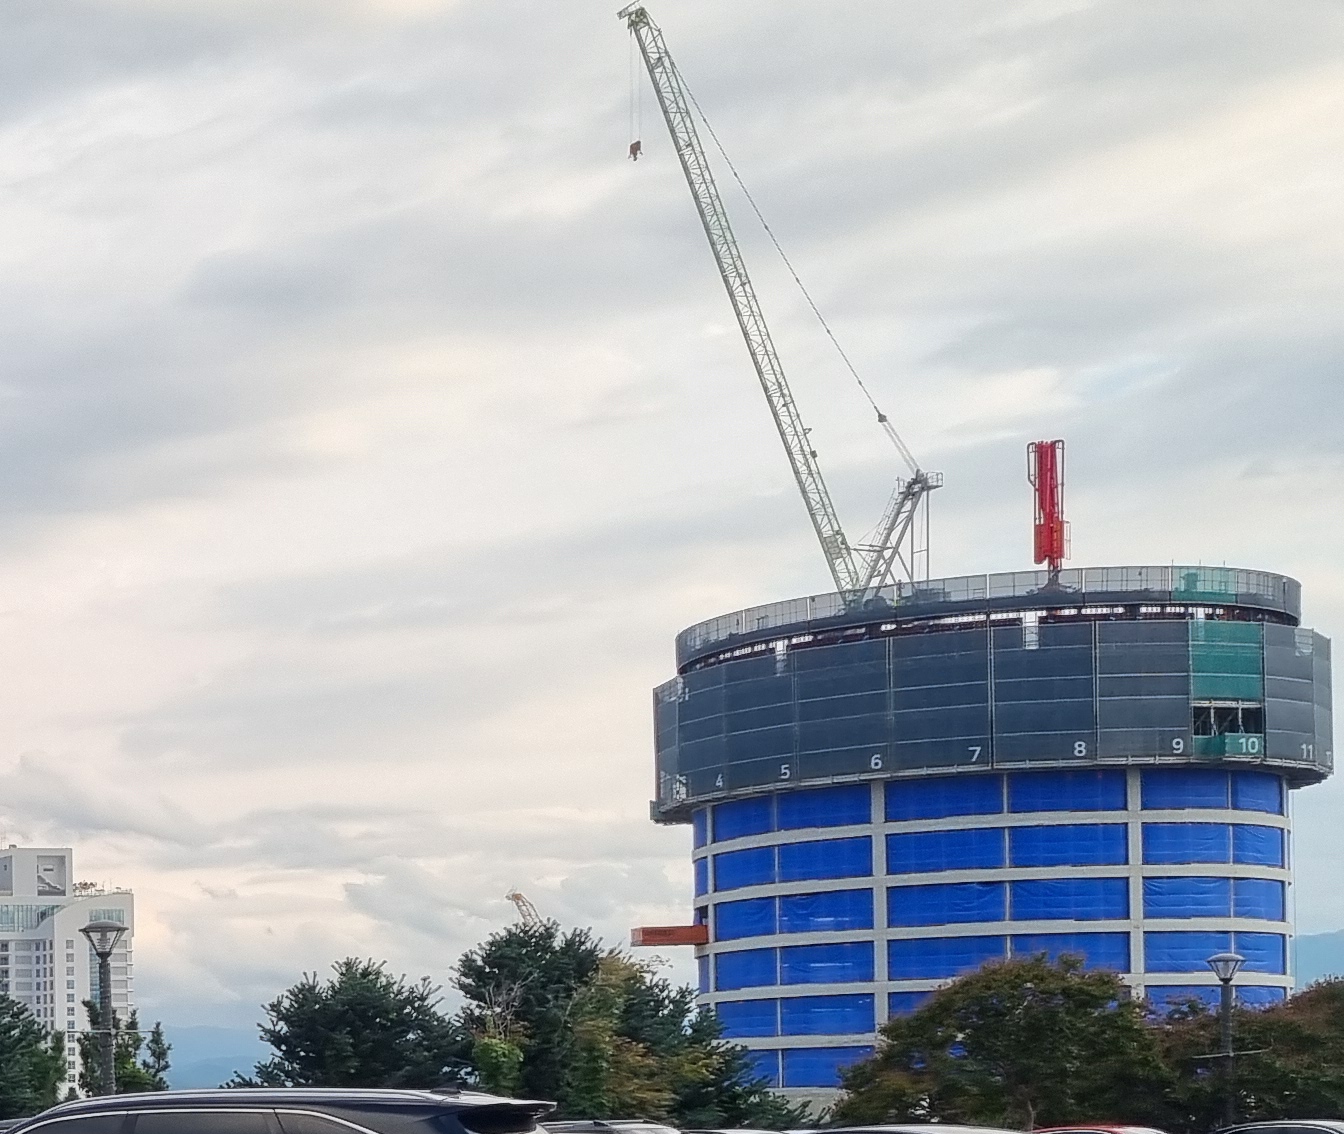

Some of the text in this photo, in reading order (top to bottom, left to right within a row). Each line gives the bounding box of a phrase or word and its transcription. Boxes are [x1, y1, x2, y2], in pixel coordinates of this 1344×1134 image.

[1073, 741, 1087, 757] 8
[1172, 738, 1184, 754] 9
[1238, 737, 1259, 753] 10
[1300, 743, 1313, 760] 11
[870, 754, 882, 770] 6
[967, 746, 982, 762] 7
[780, 764, 791, 779] 5
[715, 773, 724, 788] 4
